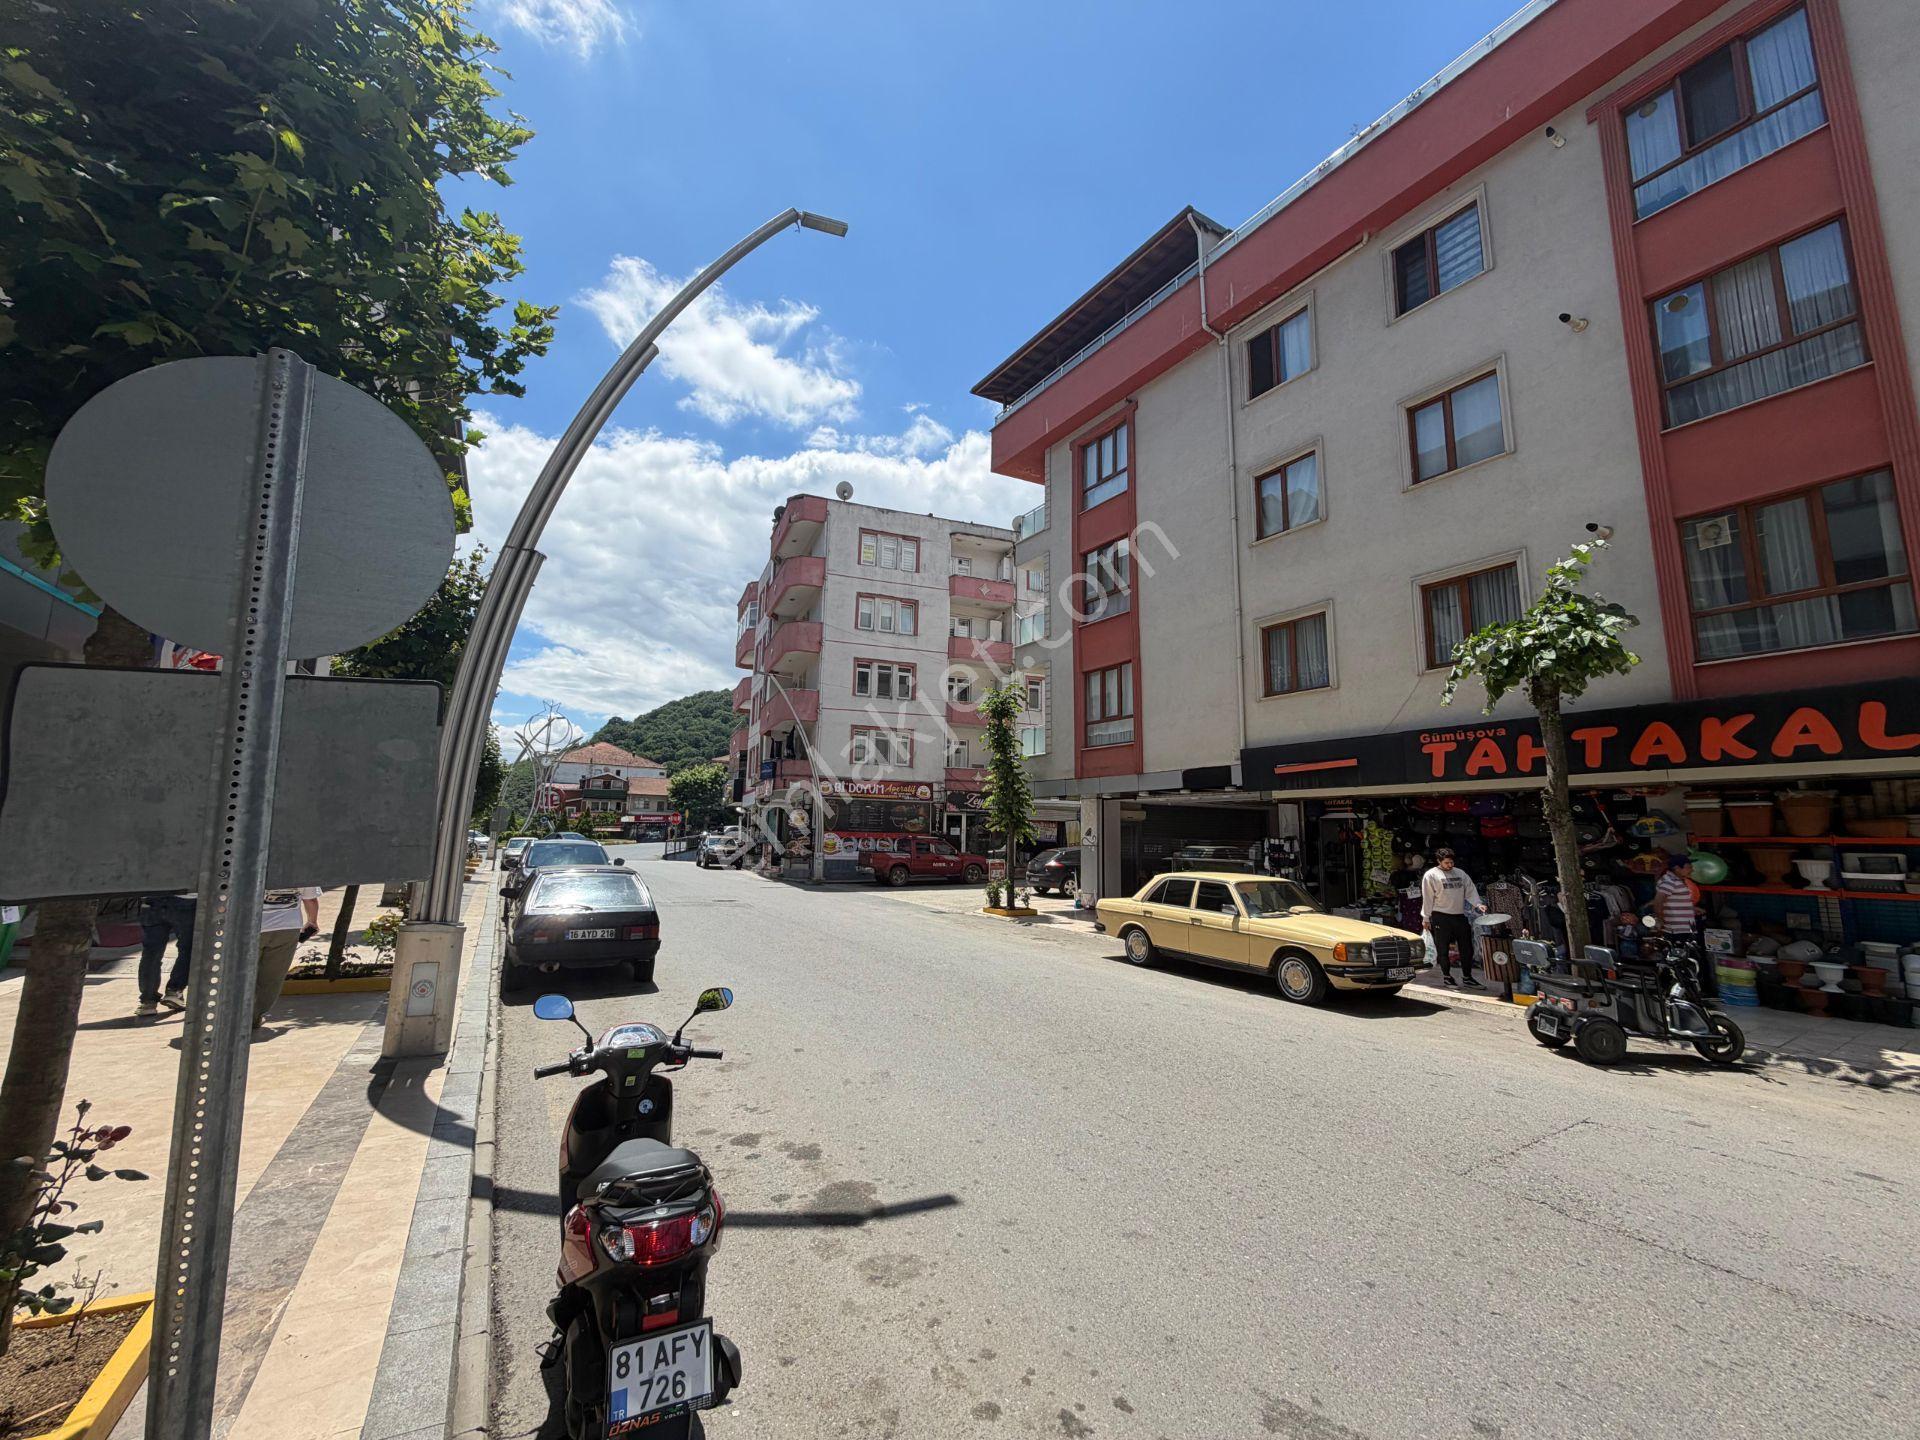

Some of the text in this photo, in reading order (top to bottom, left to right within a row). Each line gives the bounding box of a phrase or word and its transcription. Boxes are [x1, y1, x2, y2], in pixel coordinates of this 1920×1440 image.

[1420, 728, 1507, 743] Gümüşova
[581, 930, 598, 938] AYD
[616, 1329, 706, 1379] 81 AFY
[640, 1370, 687, 1410] 726
[608, 1411, 661, 1437] ÖZNAS
[613, 1409, 625, 1420] TR
